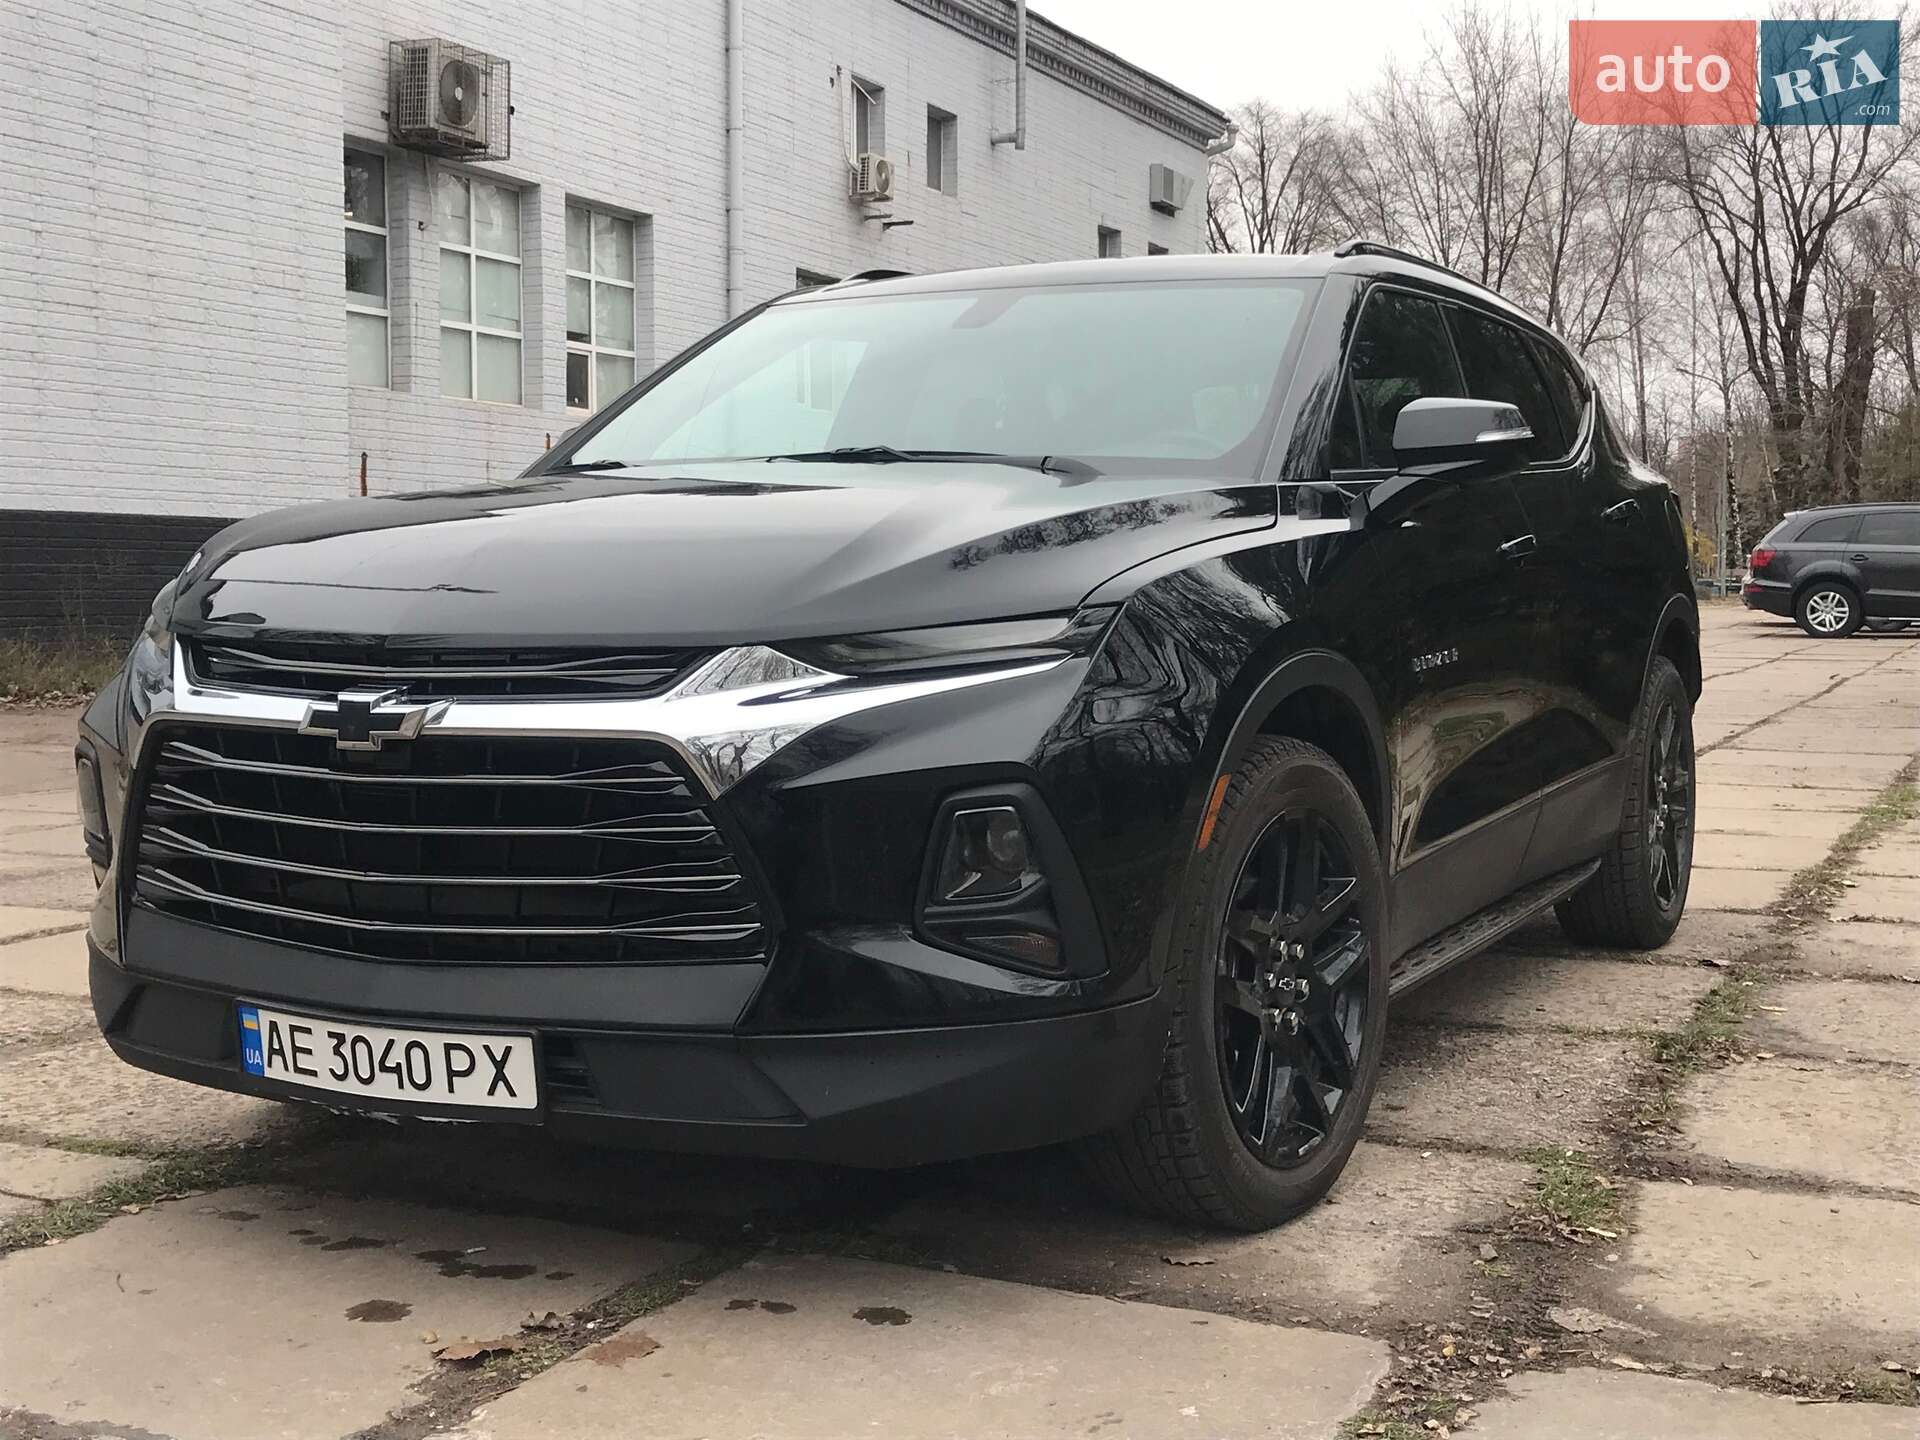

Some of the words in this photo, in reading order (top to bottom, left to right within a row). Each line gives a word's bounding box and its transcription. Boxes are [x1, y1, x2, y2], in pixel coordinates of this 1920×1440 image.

[245, 1047, 262, 1066] UA
[267, 1020, 318, 1077] AE
[327, 1030, 432, 1091] 3040
[443, 1042, 517, 1097] PX
